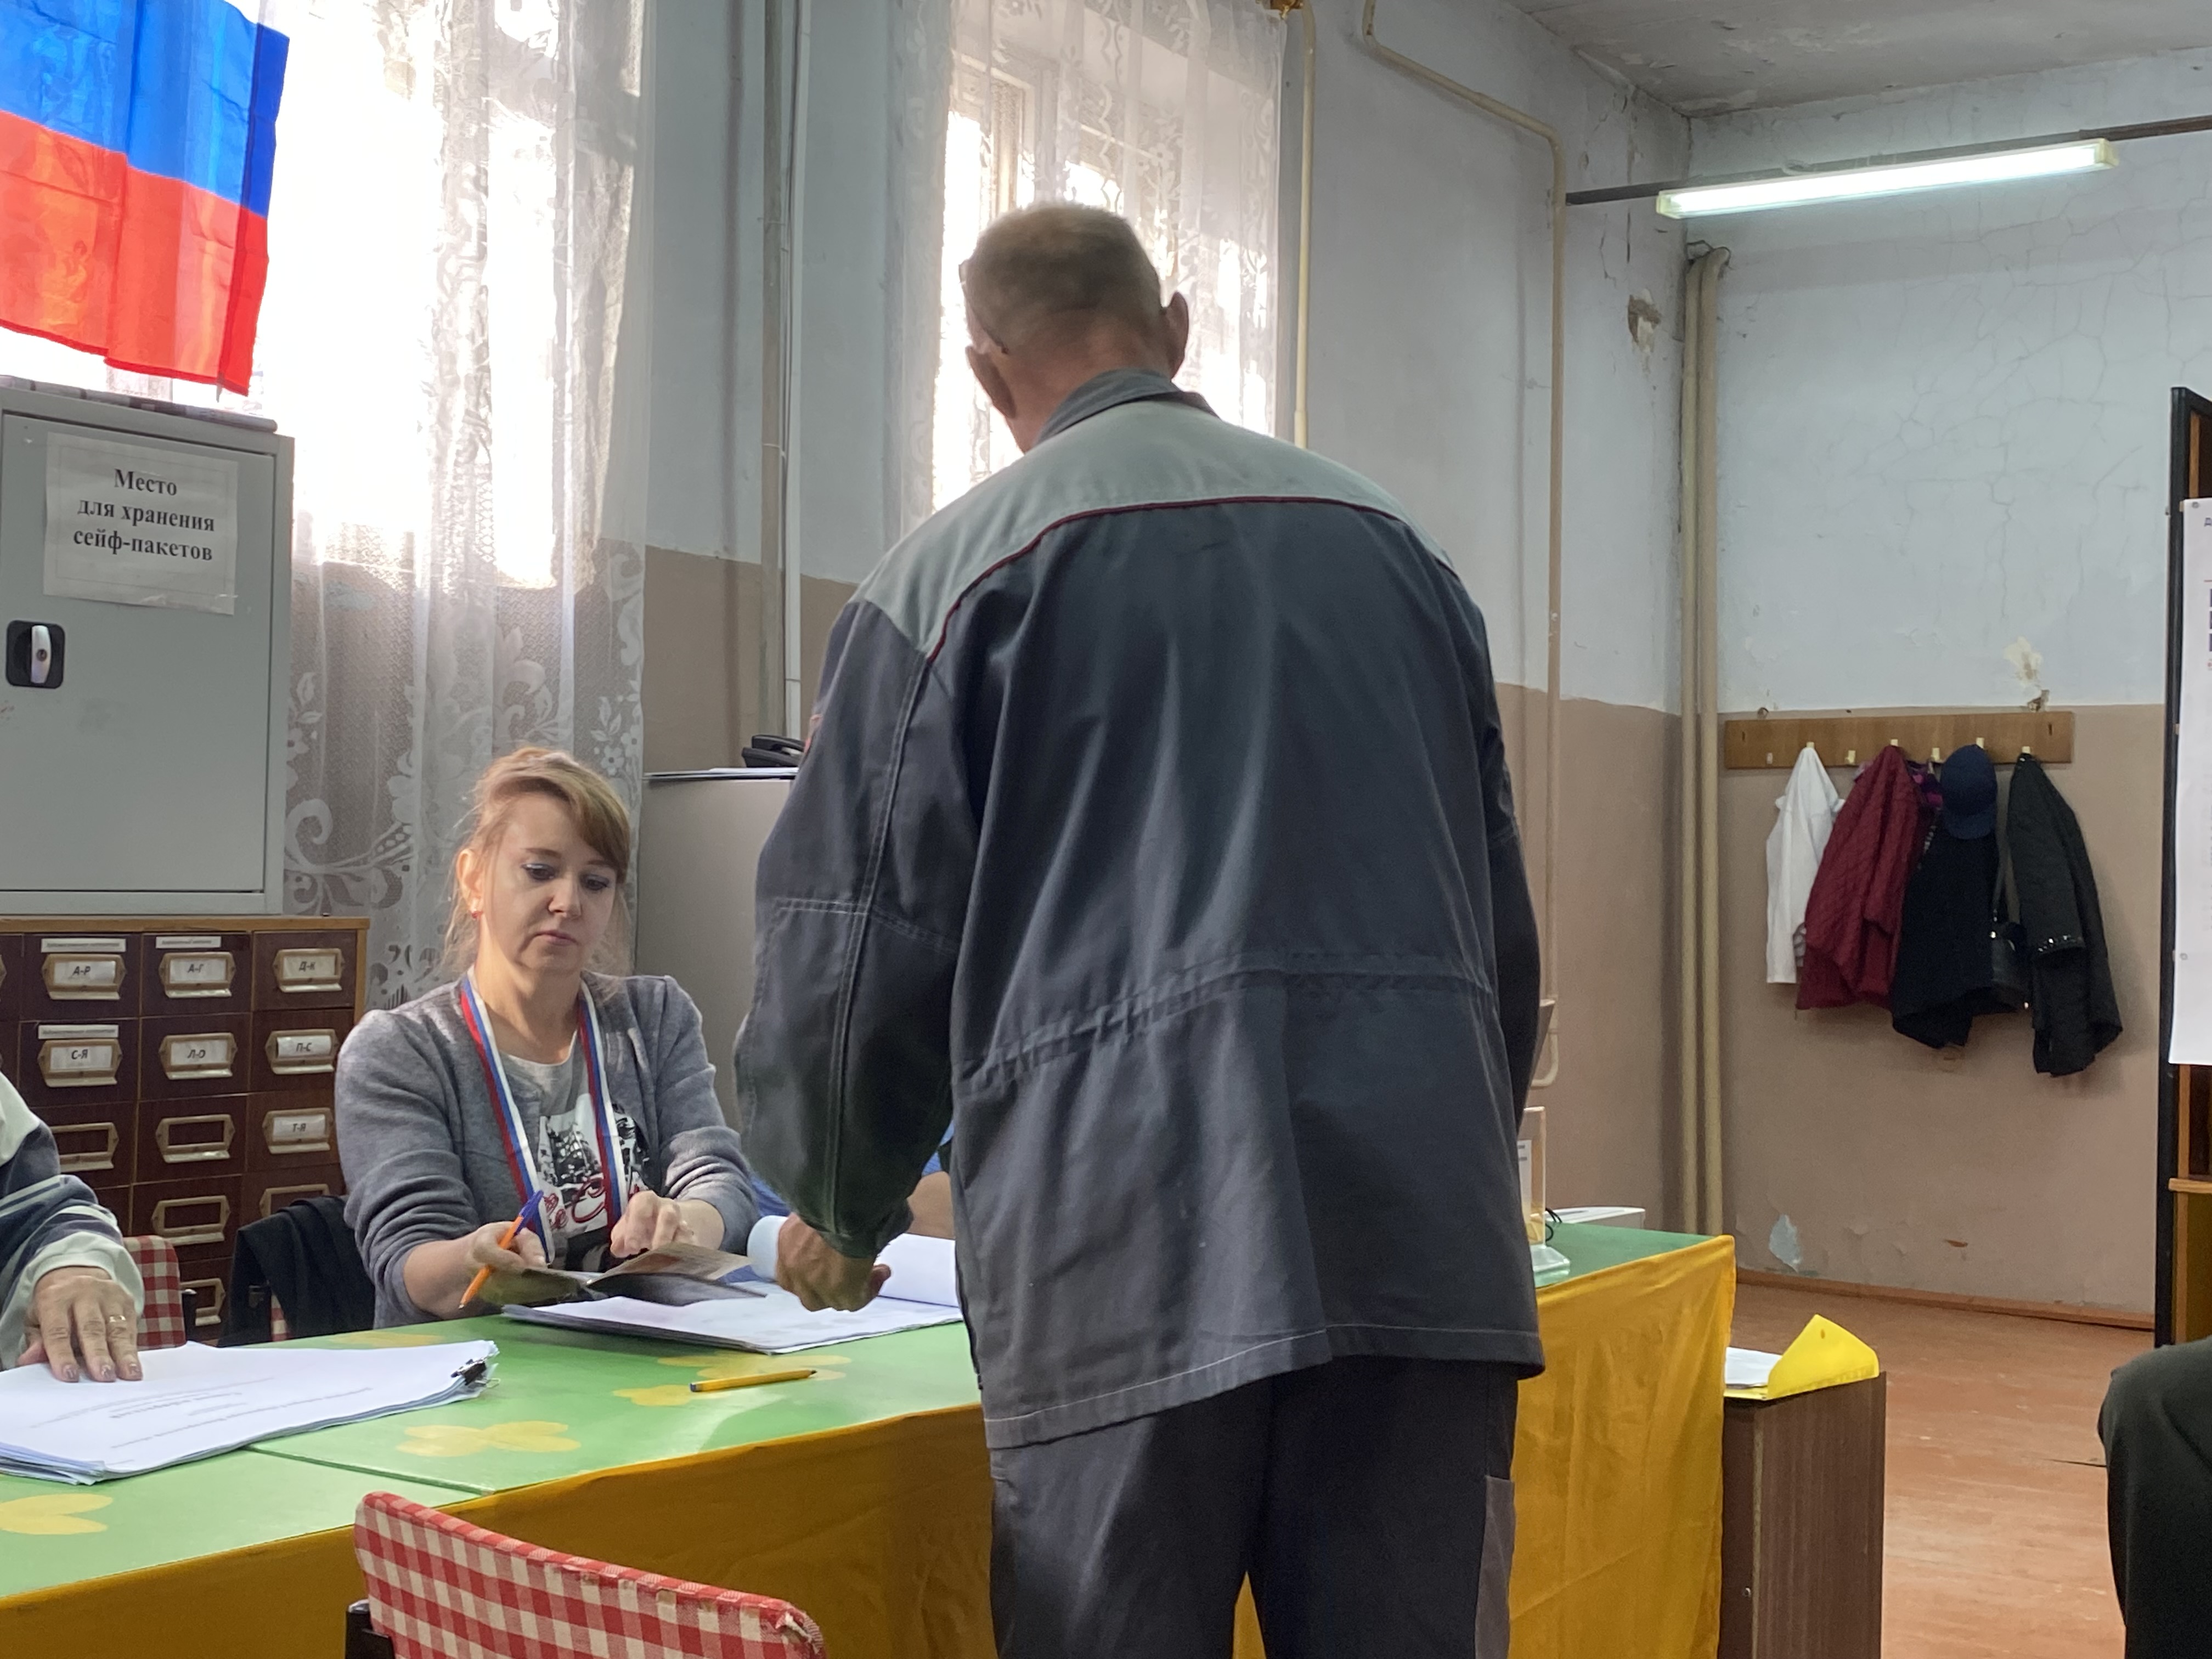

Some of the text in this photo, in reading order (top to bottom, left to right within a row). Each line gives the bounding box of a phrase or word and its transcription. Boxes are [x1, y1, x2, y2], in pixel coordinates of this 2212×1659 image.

[114, 469, 177, 496] Место
[78, 500, 215, 531] для хранения
[74, 528, 213, 561] сейф-пакетов
[72, 965, 91, 975] А-Р
[187, 964, 204, 973] А-Г
[296, 1042, 312, 1052] П-С
[71, 1049, 88, 1060] С-Я
[187, 1049, 206, 1058] Л-О
[292, 1123, 306, 1132] Т-Я
